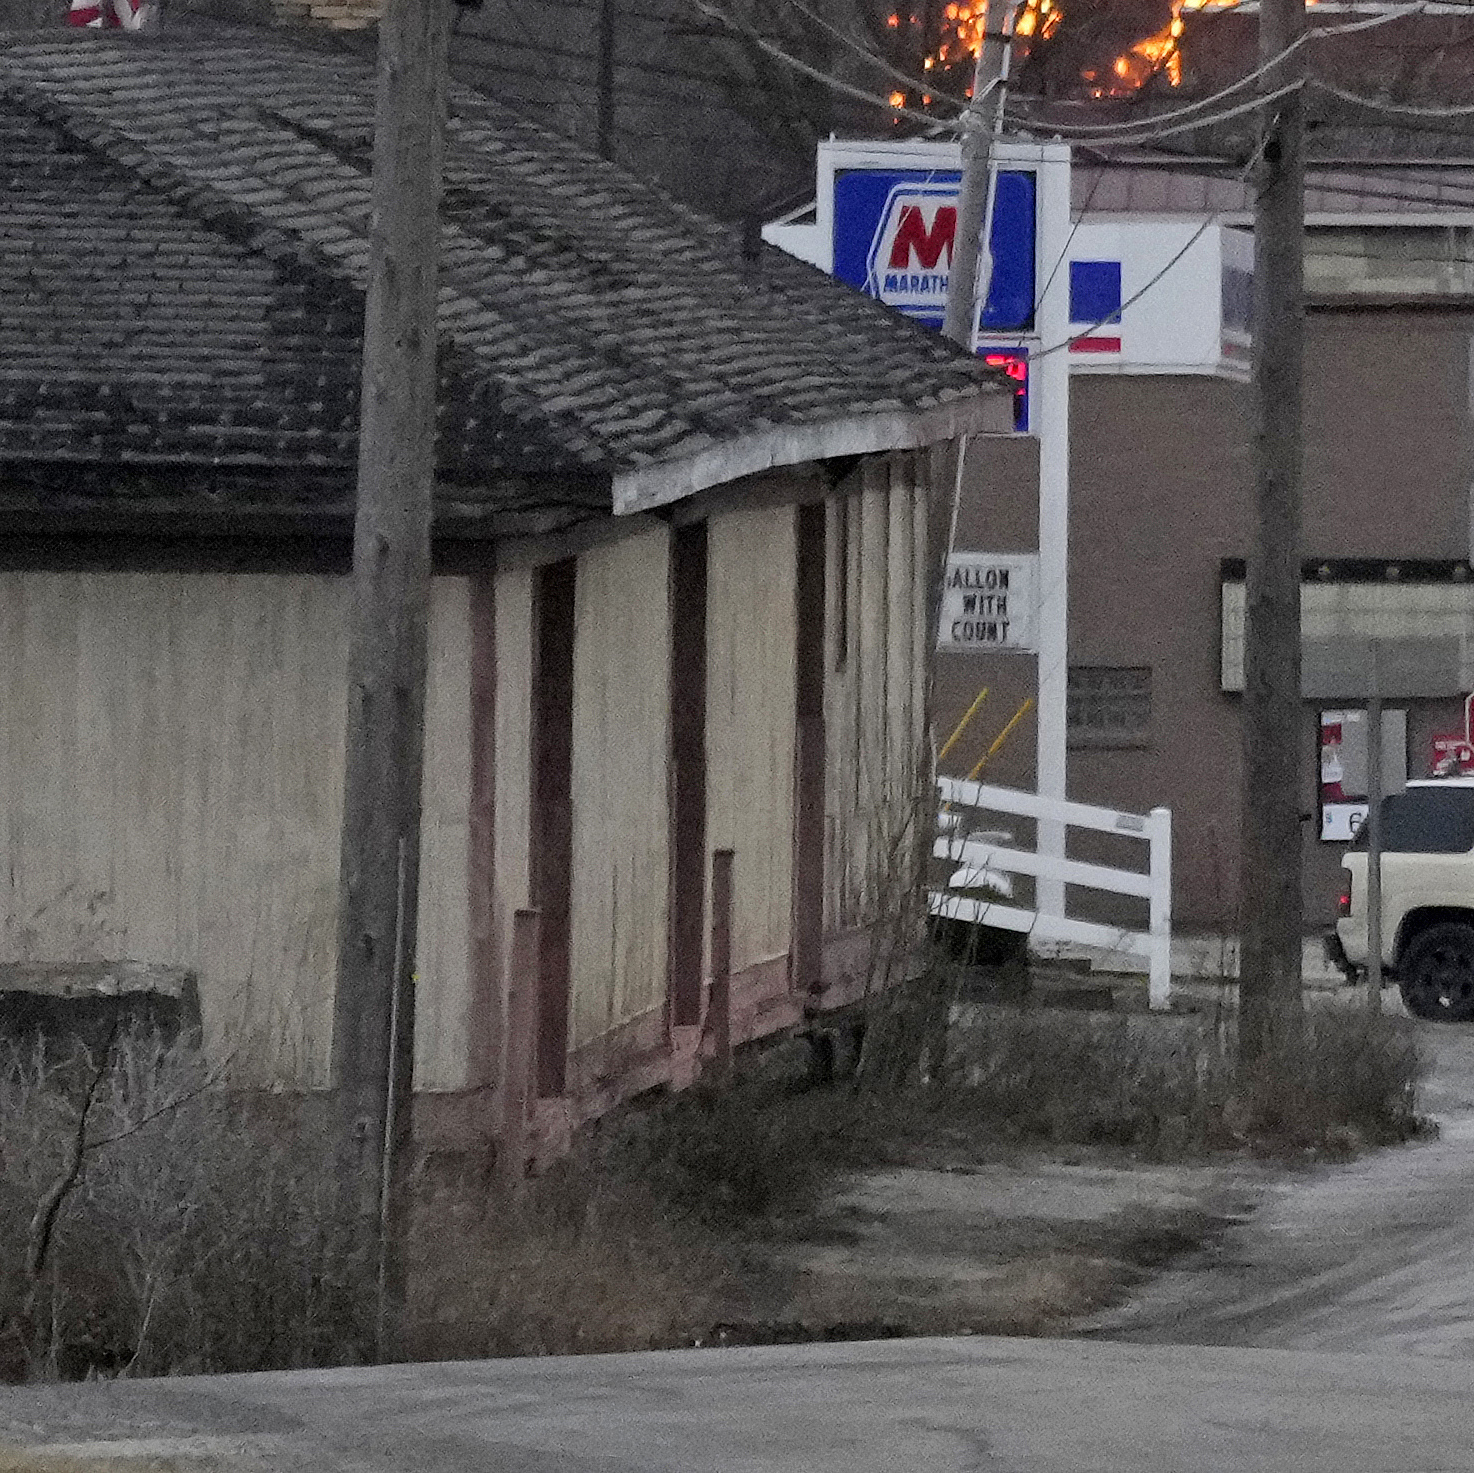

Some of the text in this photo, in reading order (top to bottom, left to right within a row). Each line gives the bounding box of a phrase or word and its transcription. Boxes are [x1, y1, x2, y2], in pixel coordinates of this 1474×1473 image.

[888, 205, 957, 270] M
[884, 274, 948, 294] MARATH
[963, 593, 1007, 615] WITH
[952, 620, 1009, 642] COUNT
